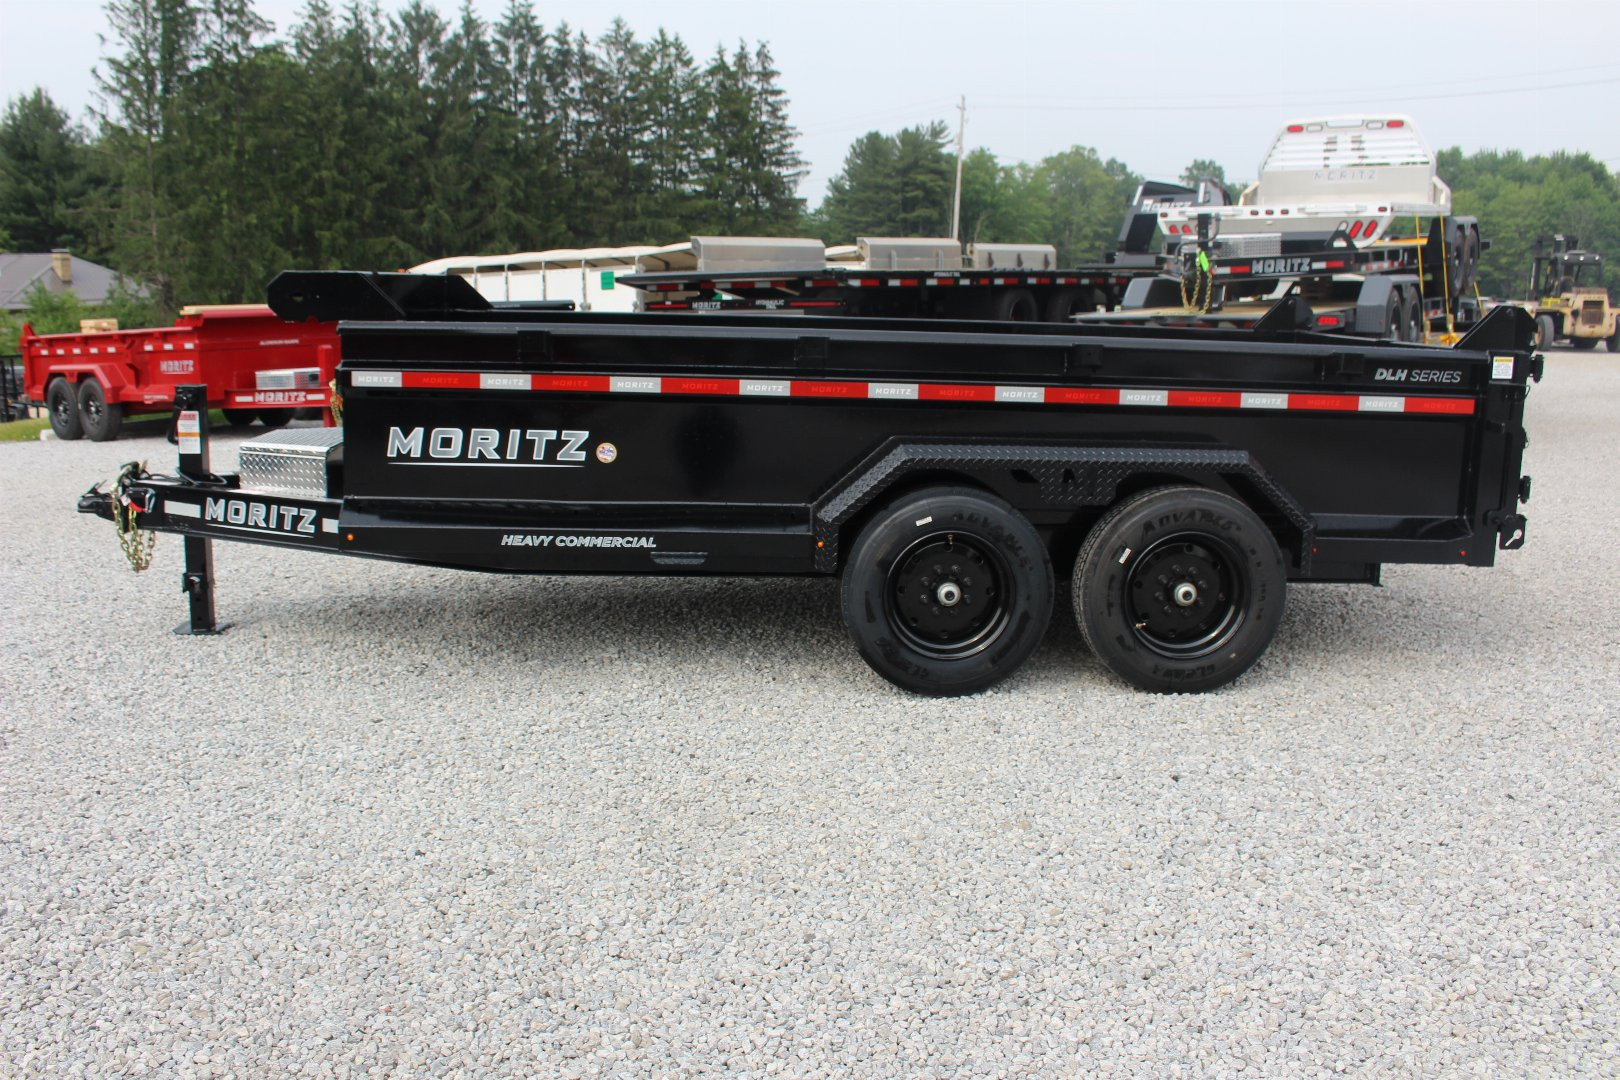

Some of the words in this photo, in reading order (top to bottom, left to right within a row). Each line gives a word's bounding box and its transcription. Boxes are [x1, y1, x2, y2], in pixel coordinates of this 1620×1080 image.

[1251, 257, 1311, 274] MORITZ
[160, 359, 194, 372] MORITZ
[1374, 367, 1409, 382] DLH
[1409, 369, 1462, 384] SERIES
[254, 391, 306, 403] MORITZ
[358, 375, 395, 384] MORITZ
[487, 377, 525, 386] MORITZ
[616, 381, 654, 389] MORITZ
[746, 384, 783, 392] MORITZ
[875, 387, 912, 395] MORITZ
[1002, 391, 1038, 399] MORITZ
[1126, 394, 1161, 402] MORITZ
[1248, 397, 1282, 405] MORITZ
[386, 426, 590, 462] MORITZ
[204, 497, 317, 534] MORITZ
[501, 534, 553, 547] HEAVY
[555, 535, 657, 548] COMMERCIAL
